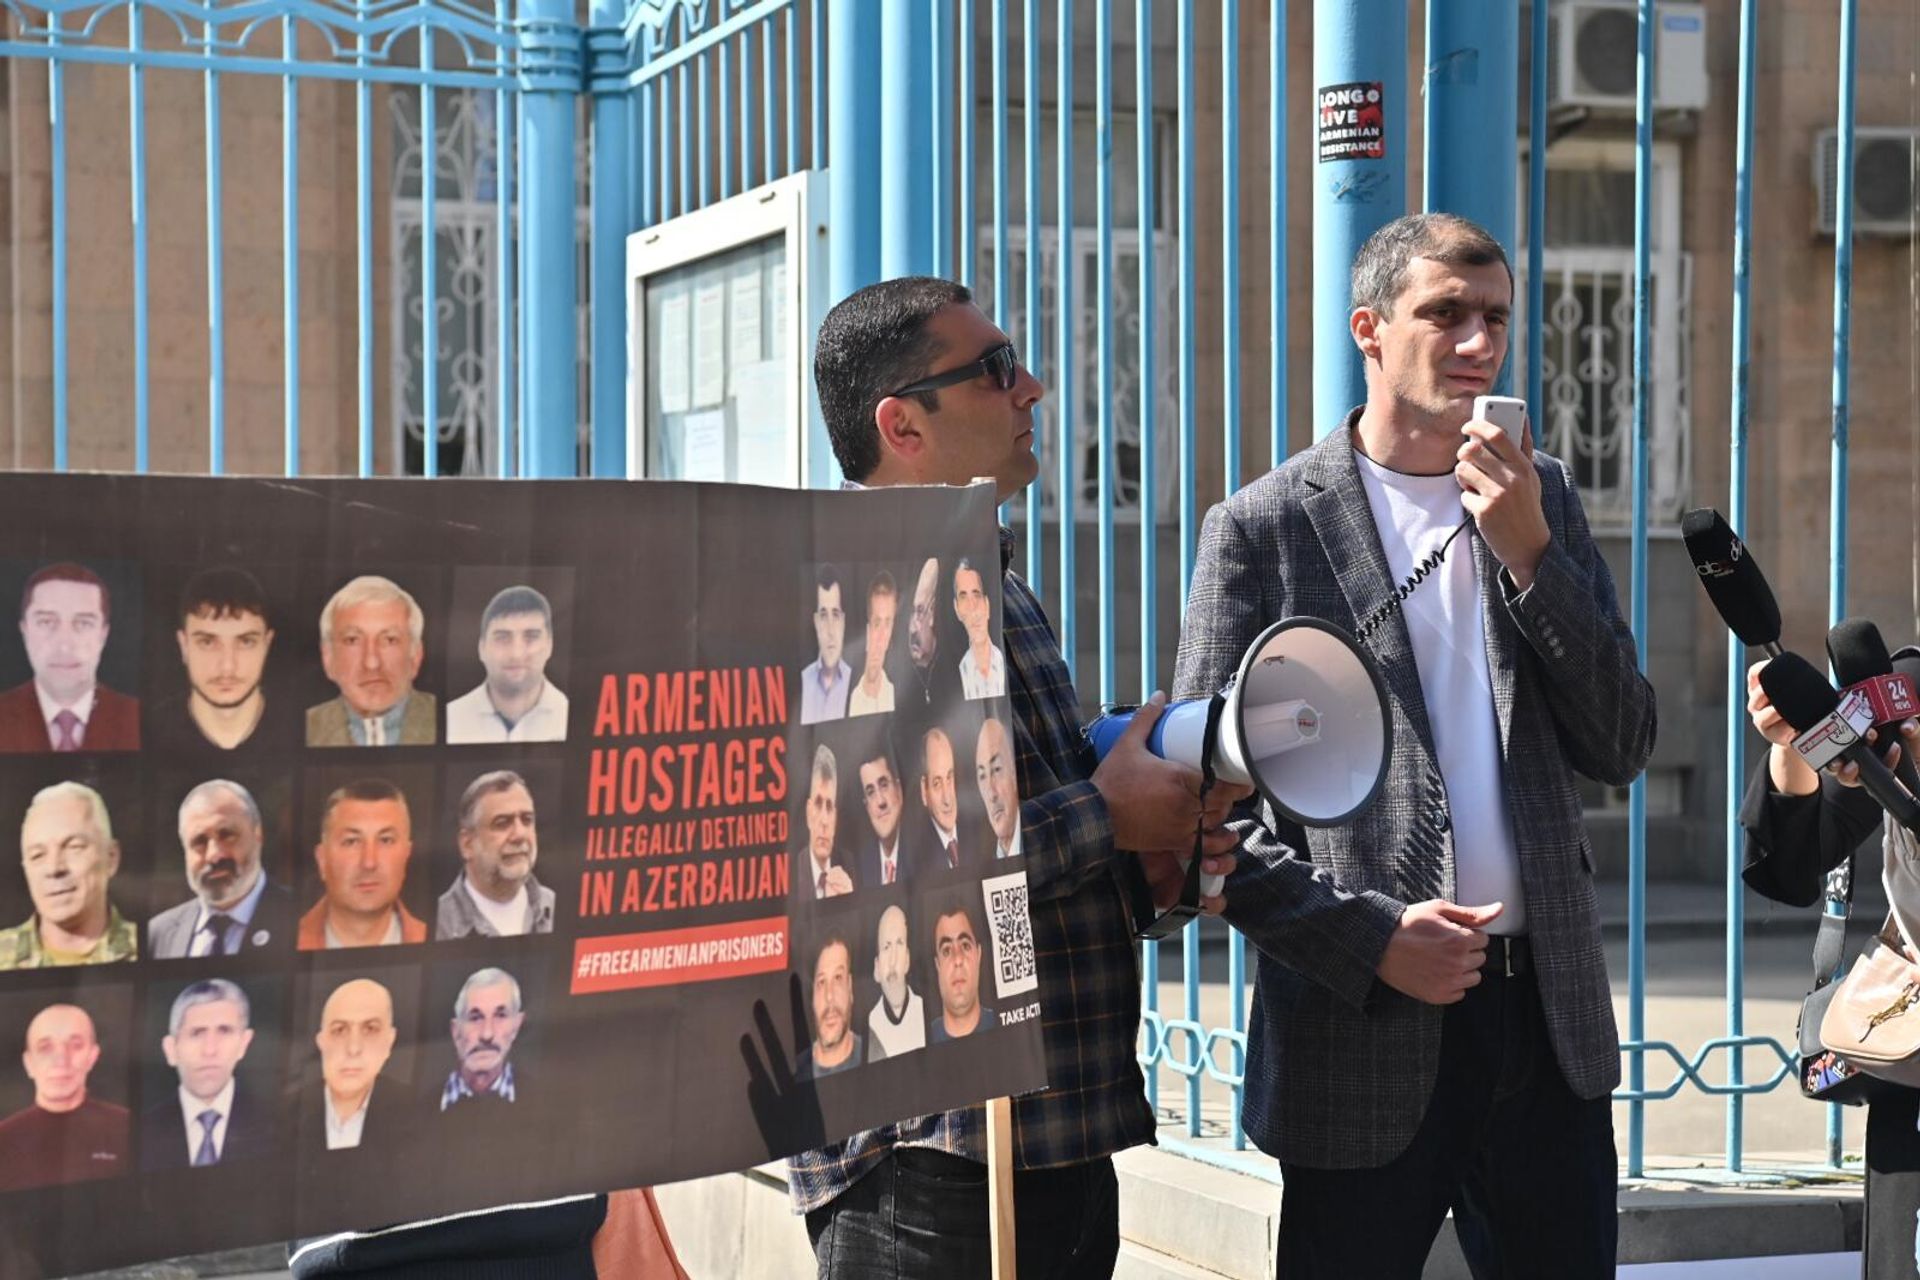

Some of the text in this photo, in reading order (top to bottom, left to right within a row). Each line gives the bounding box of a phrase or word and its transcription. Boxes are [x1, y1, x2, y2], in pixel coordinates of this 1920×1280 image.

[1320, 89, 1364, 108] LONG
[1320, 109, 1358, 128] LIVE
[1320, 127, 1380, 142] ARMENIAN
[1321, 141, 1380, 156] RESISTANCE
[1888, 680, 1908, 700] 24
[593, 665, 787, 737] ARMENIAN
[587, 735, 787, 816] HOSTAGES
[586, 810, 788, 861] ILLEGALLY DETAINED
[579, 853, 789, 917] IN AZERBAIJAN
[577, 931, 784, 978] #FREEARMENIANPRISONERS
[999, 1007, 1026, 1026] TAKE
